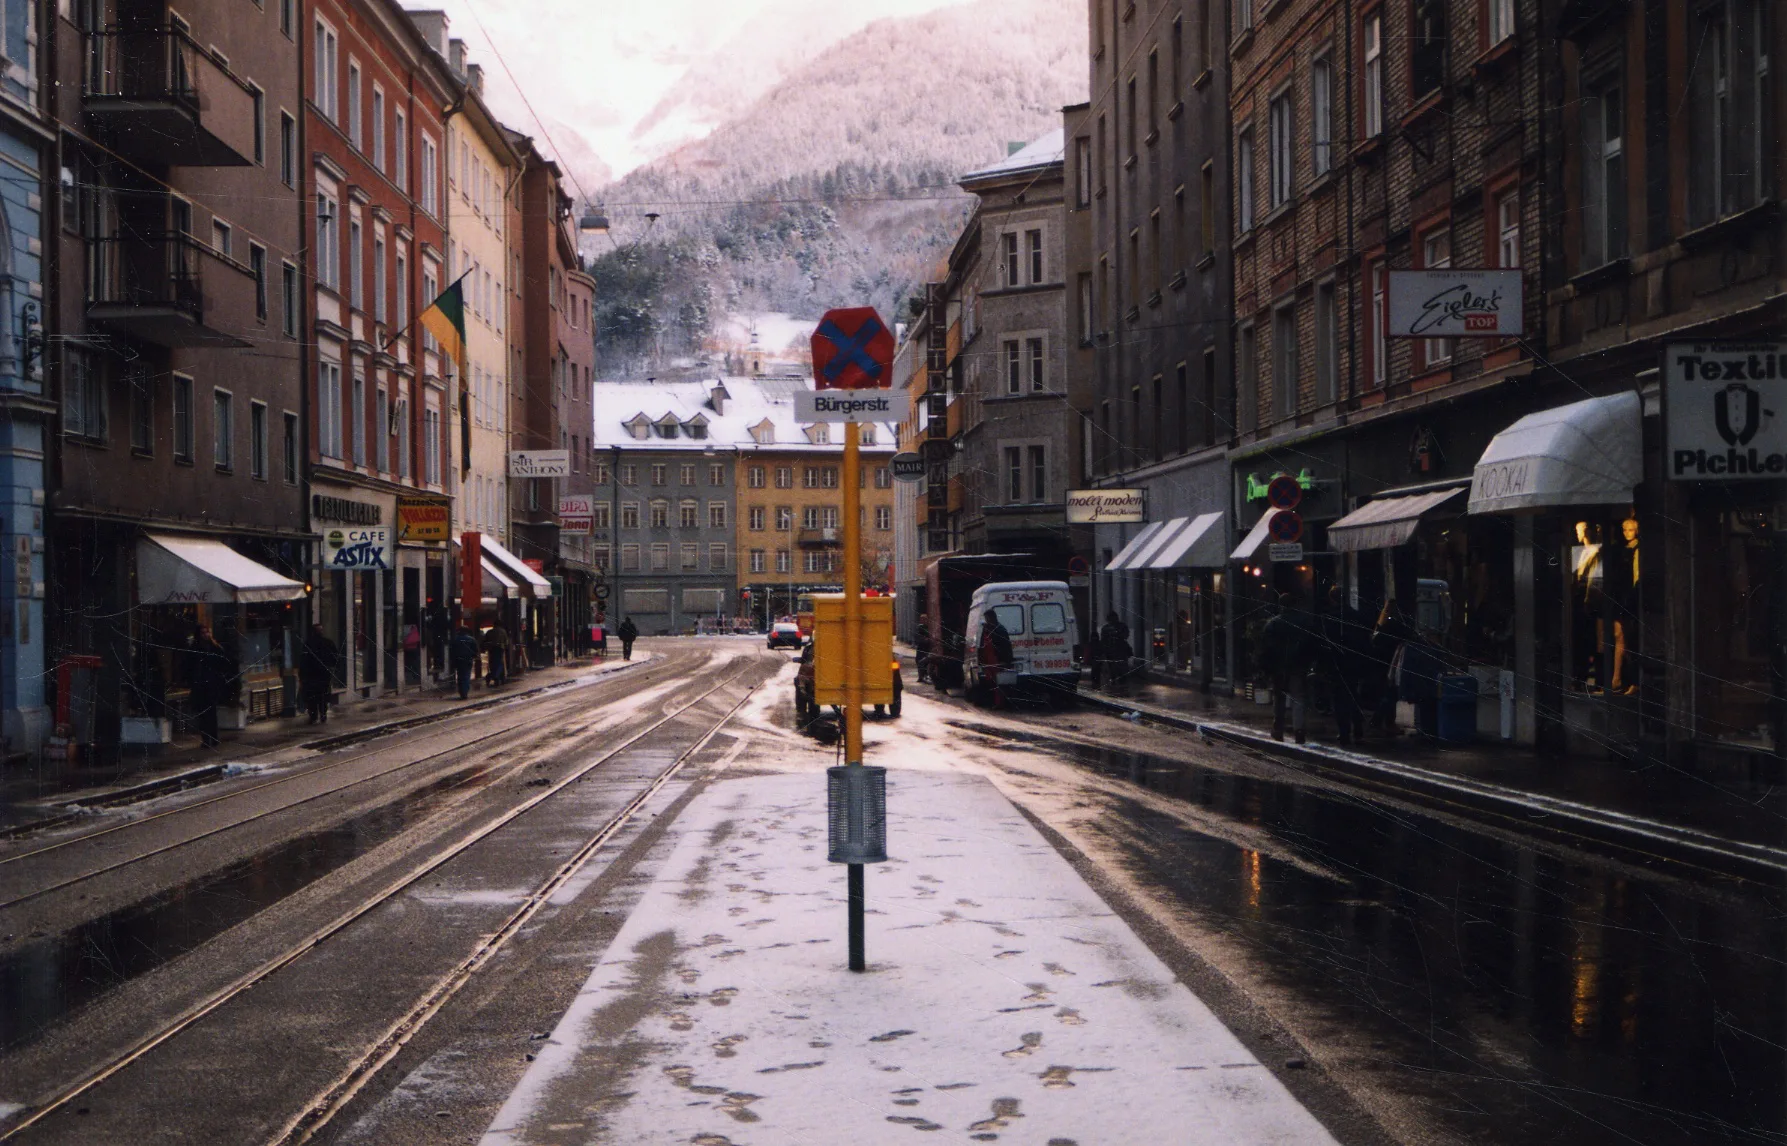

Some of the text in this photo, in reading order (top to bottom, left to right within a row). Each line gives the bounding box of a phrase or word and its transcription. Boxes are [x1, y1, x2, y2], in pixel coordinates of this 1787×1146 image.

[1468, 317, 1496, 328] TOP
[815, 397, 889, 414] Bürgerstr.
[512, 458, 533, 467] SIR
[1674, 448, 1787, 475] Pichle
[512, 466, 566, 475] ANTHONY
[895, 461, 925, 475] MAIR
[1478, 464, 1529, 499] KOOKAI
[1104, 493, 1142, 506] moden
[559, 501, 589, 512] BIPA
[560, 519, 589, 529] iona
[349, 531, 385, 541] CAFE
[333, 541, 387, 569] ASTIX
[1001, 591, 1054, 603] F&F
